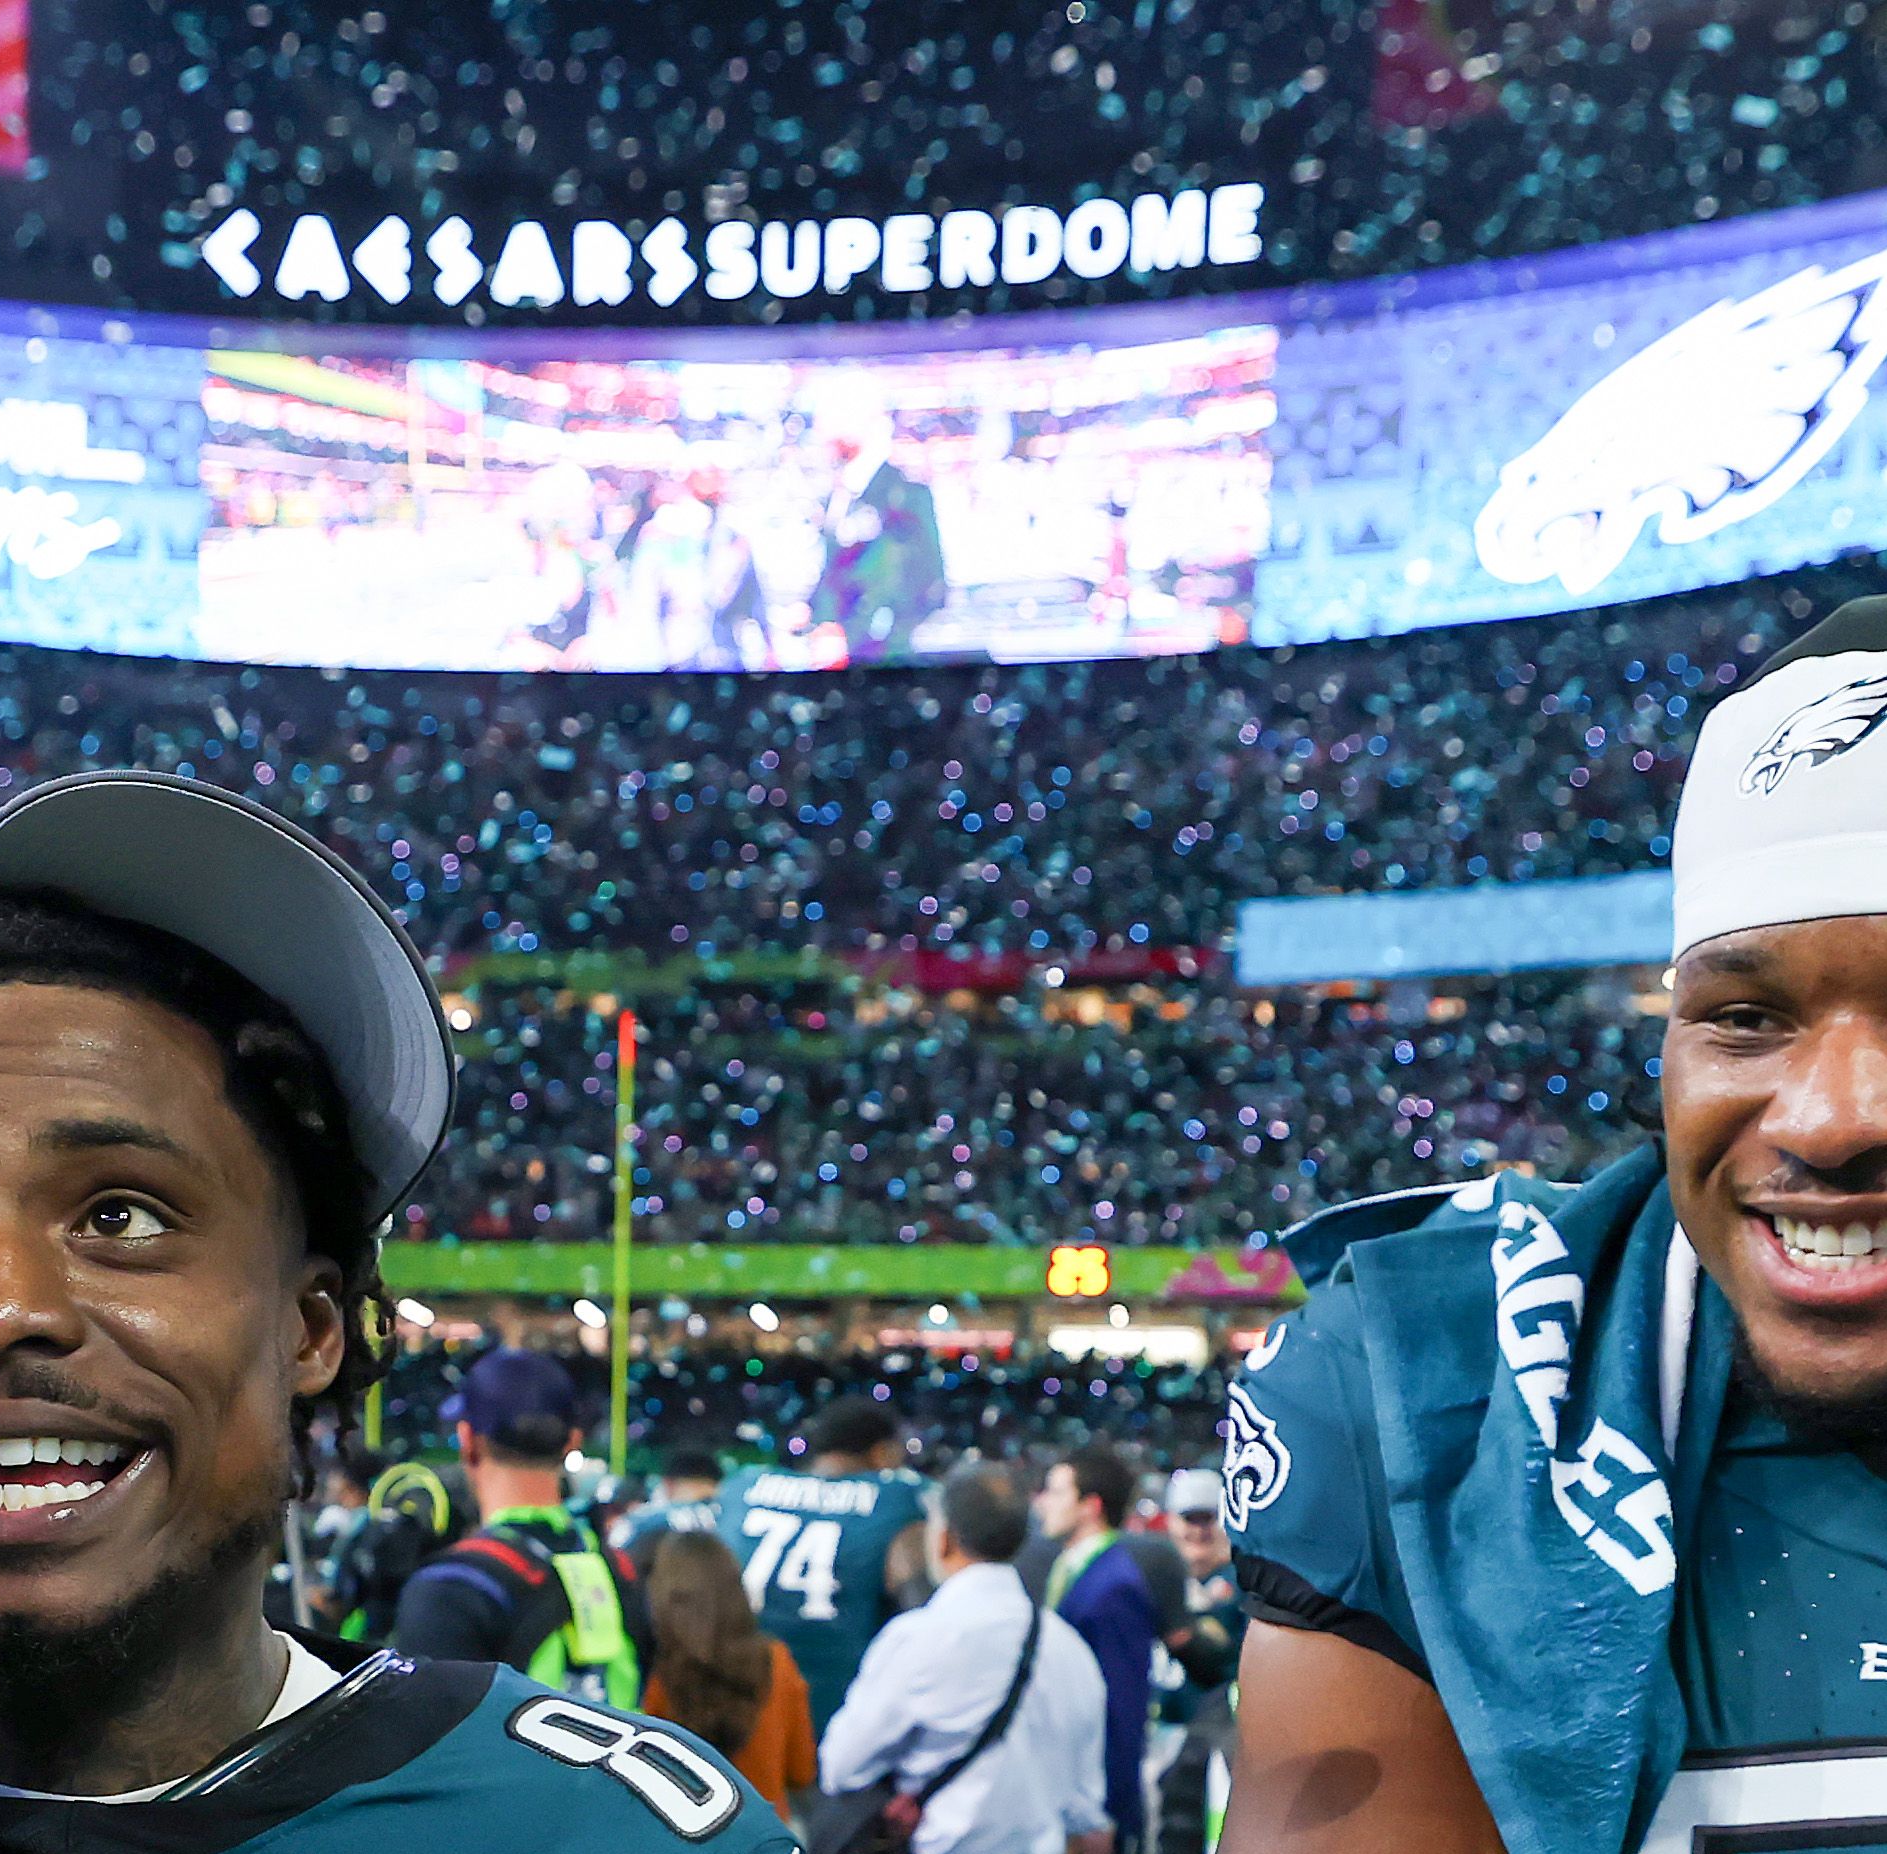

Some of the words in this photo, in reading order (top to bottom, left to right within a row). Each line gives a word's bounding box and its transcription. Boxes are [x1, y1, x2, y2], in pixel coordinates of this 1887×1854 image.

[201, 206, 699, 308] CAESARS
[703, 182, 1264, 301] SUPERDOME
[741, 1507, 843, 1621] 74
[505, 1695, 743, 1843] 8
